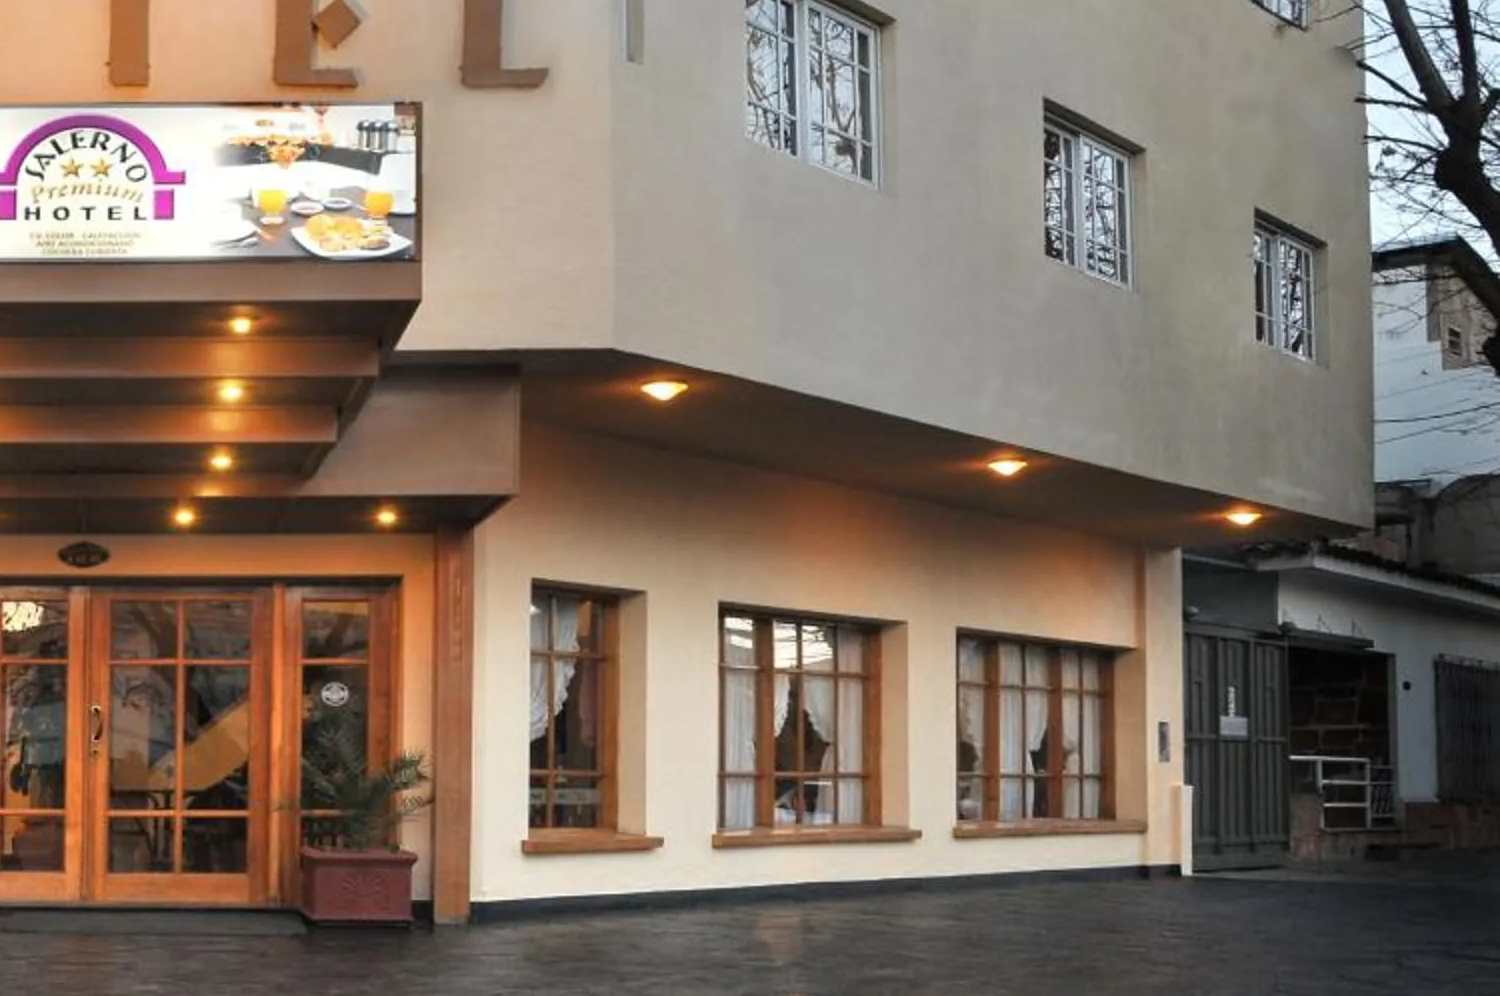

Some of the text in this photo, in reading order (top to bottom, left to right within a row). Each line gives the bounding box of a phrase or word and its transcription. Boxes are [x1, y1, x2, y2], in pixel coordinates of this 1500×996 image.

[25, 129, 148, 183] SALERNO
[30, 177, 145, 204] Premium
[24, 206, 147, 221] HOTEL
